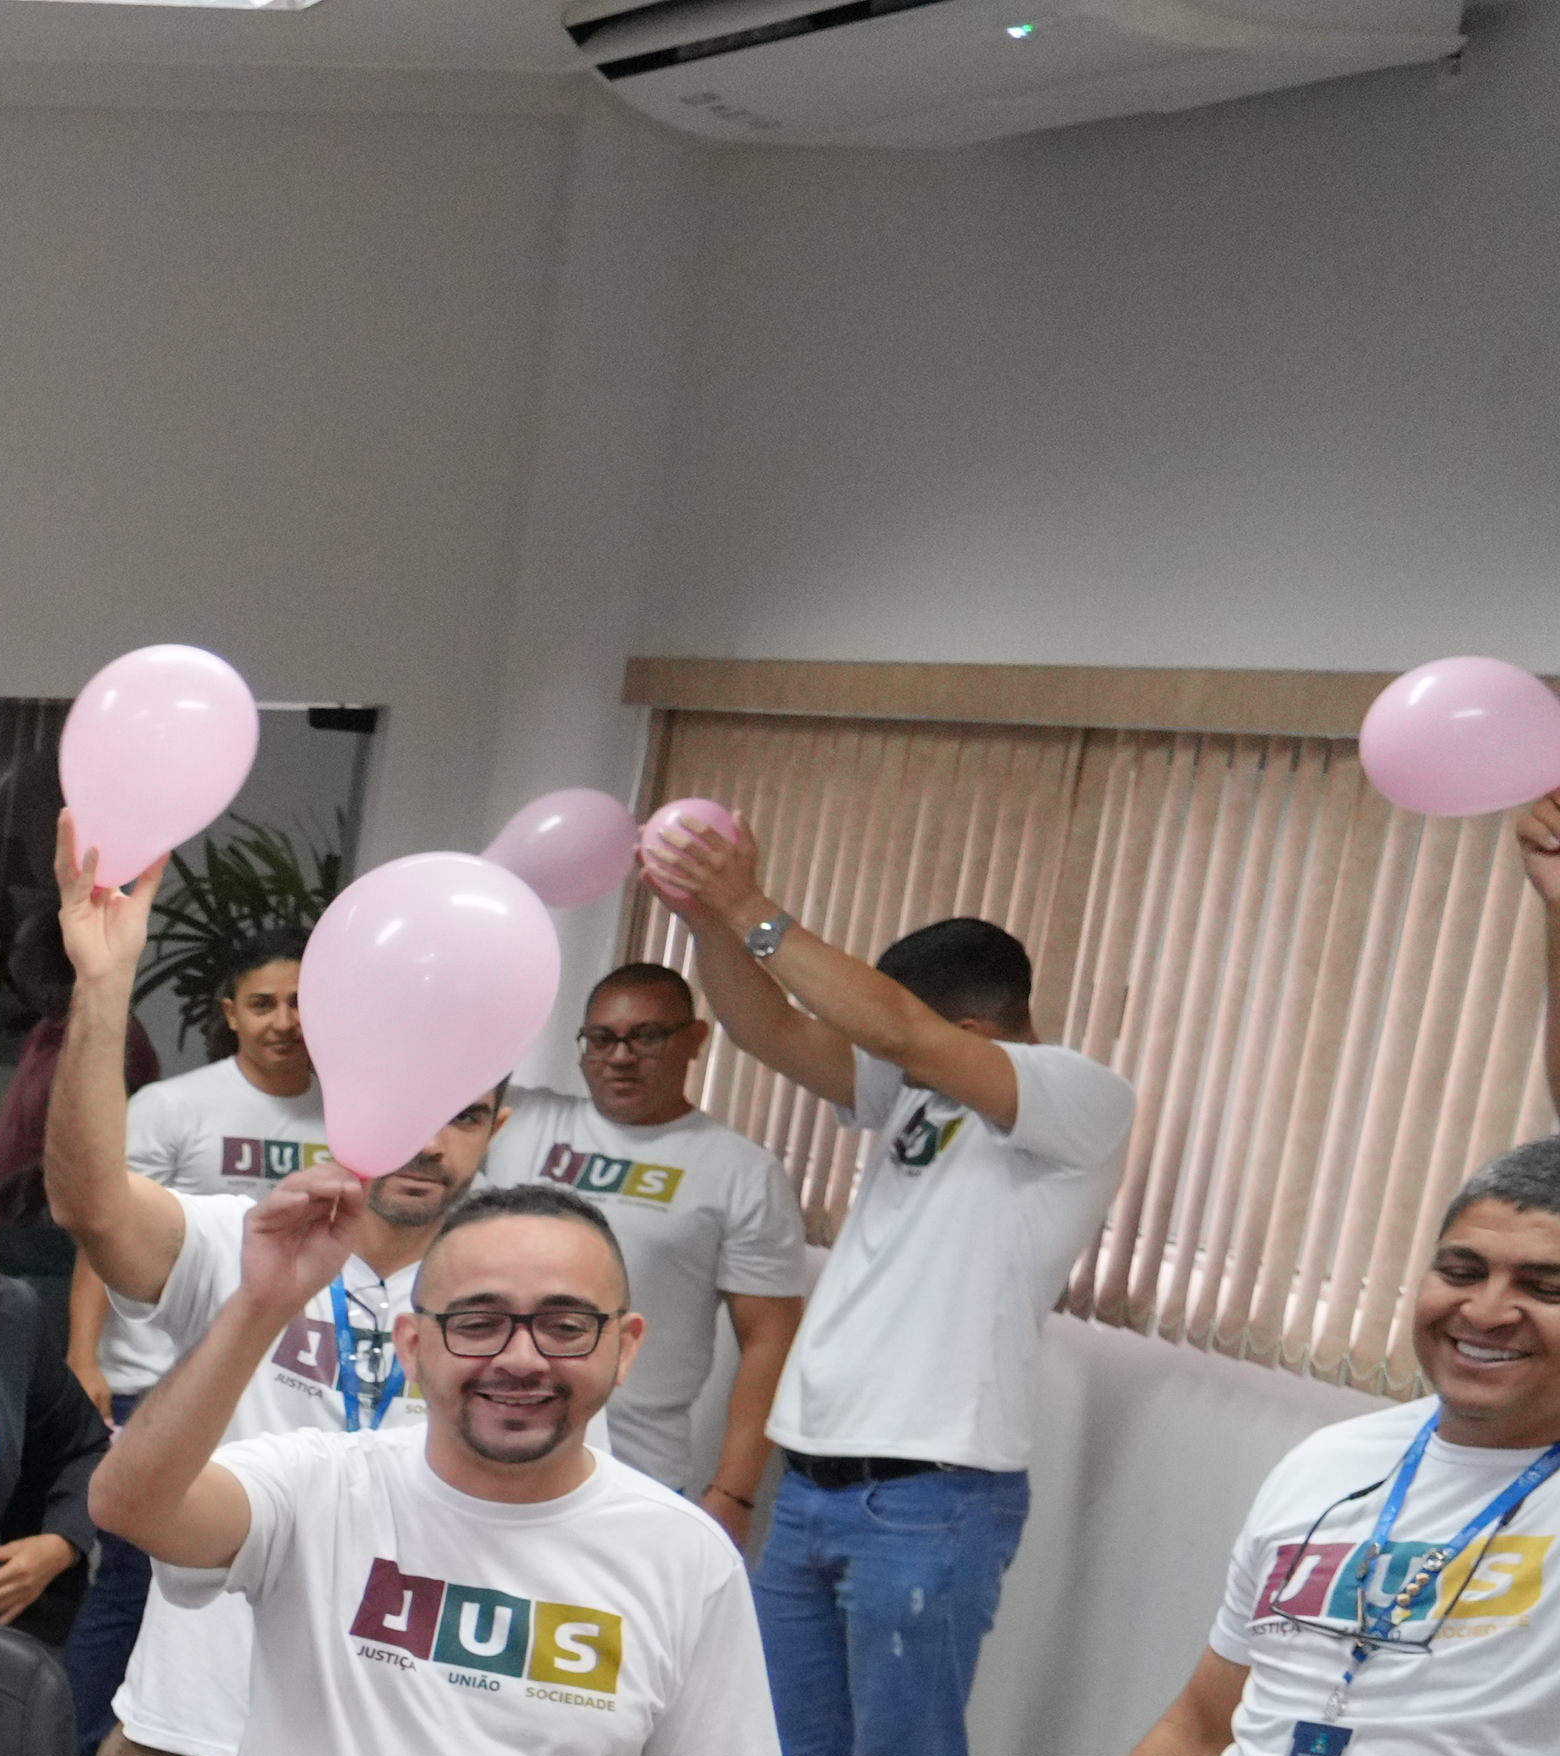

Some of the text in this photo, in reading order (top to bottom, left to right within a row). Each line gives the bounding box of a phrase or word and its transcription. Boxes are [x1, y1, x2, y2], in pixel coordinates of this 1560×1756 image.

[551, 1150, 669, 1195] JUS
[274, 1373, 324, 1399] JUSTIÇA
[381, 1589, 601, 1674] JUS
[356, 1645, 617, 1713] JUSTIÇA UNIÃO SOCIEDADE
